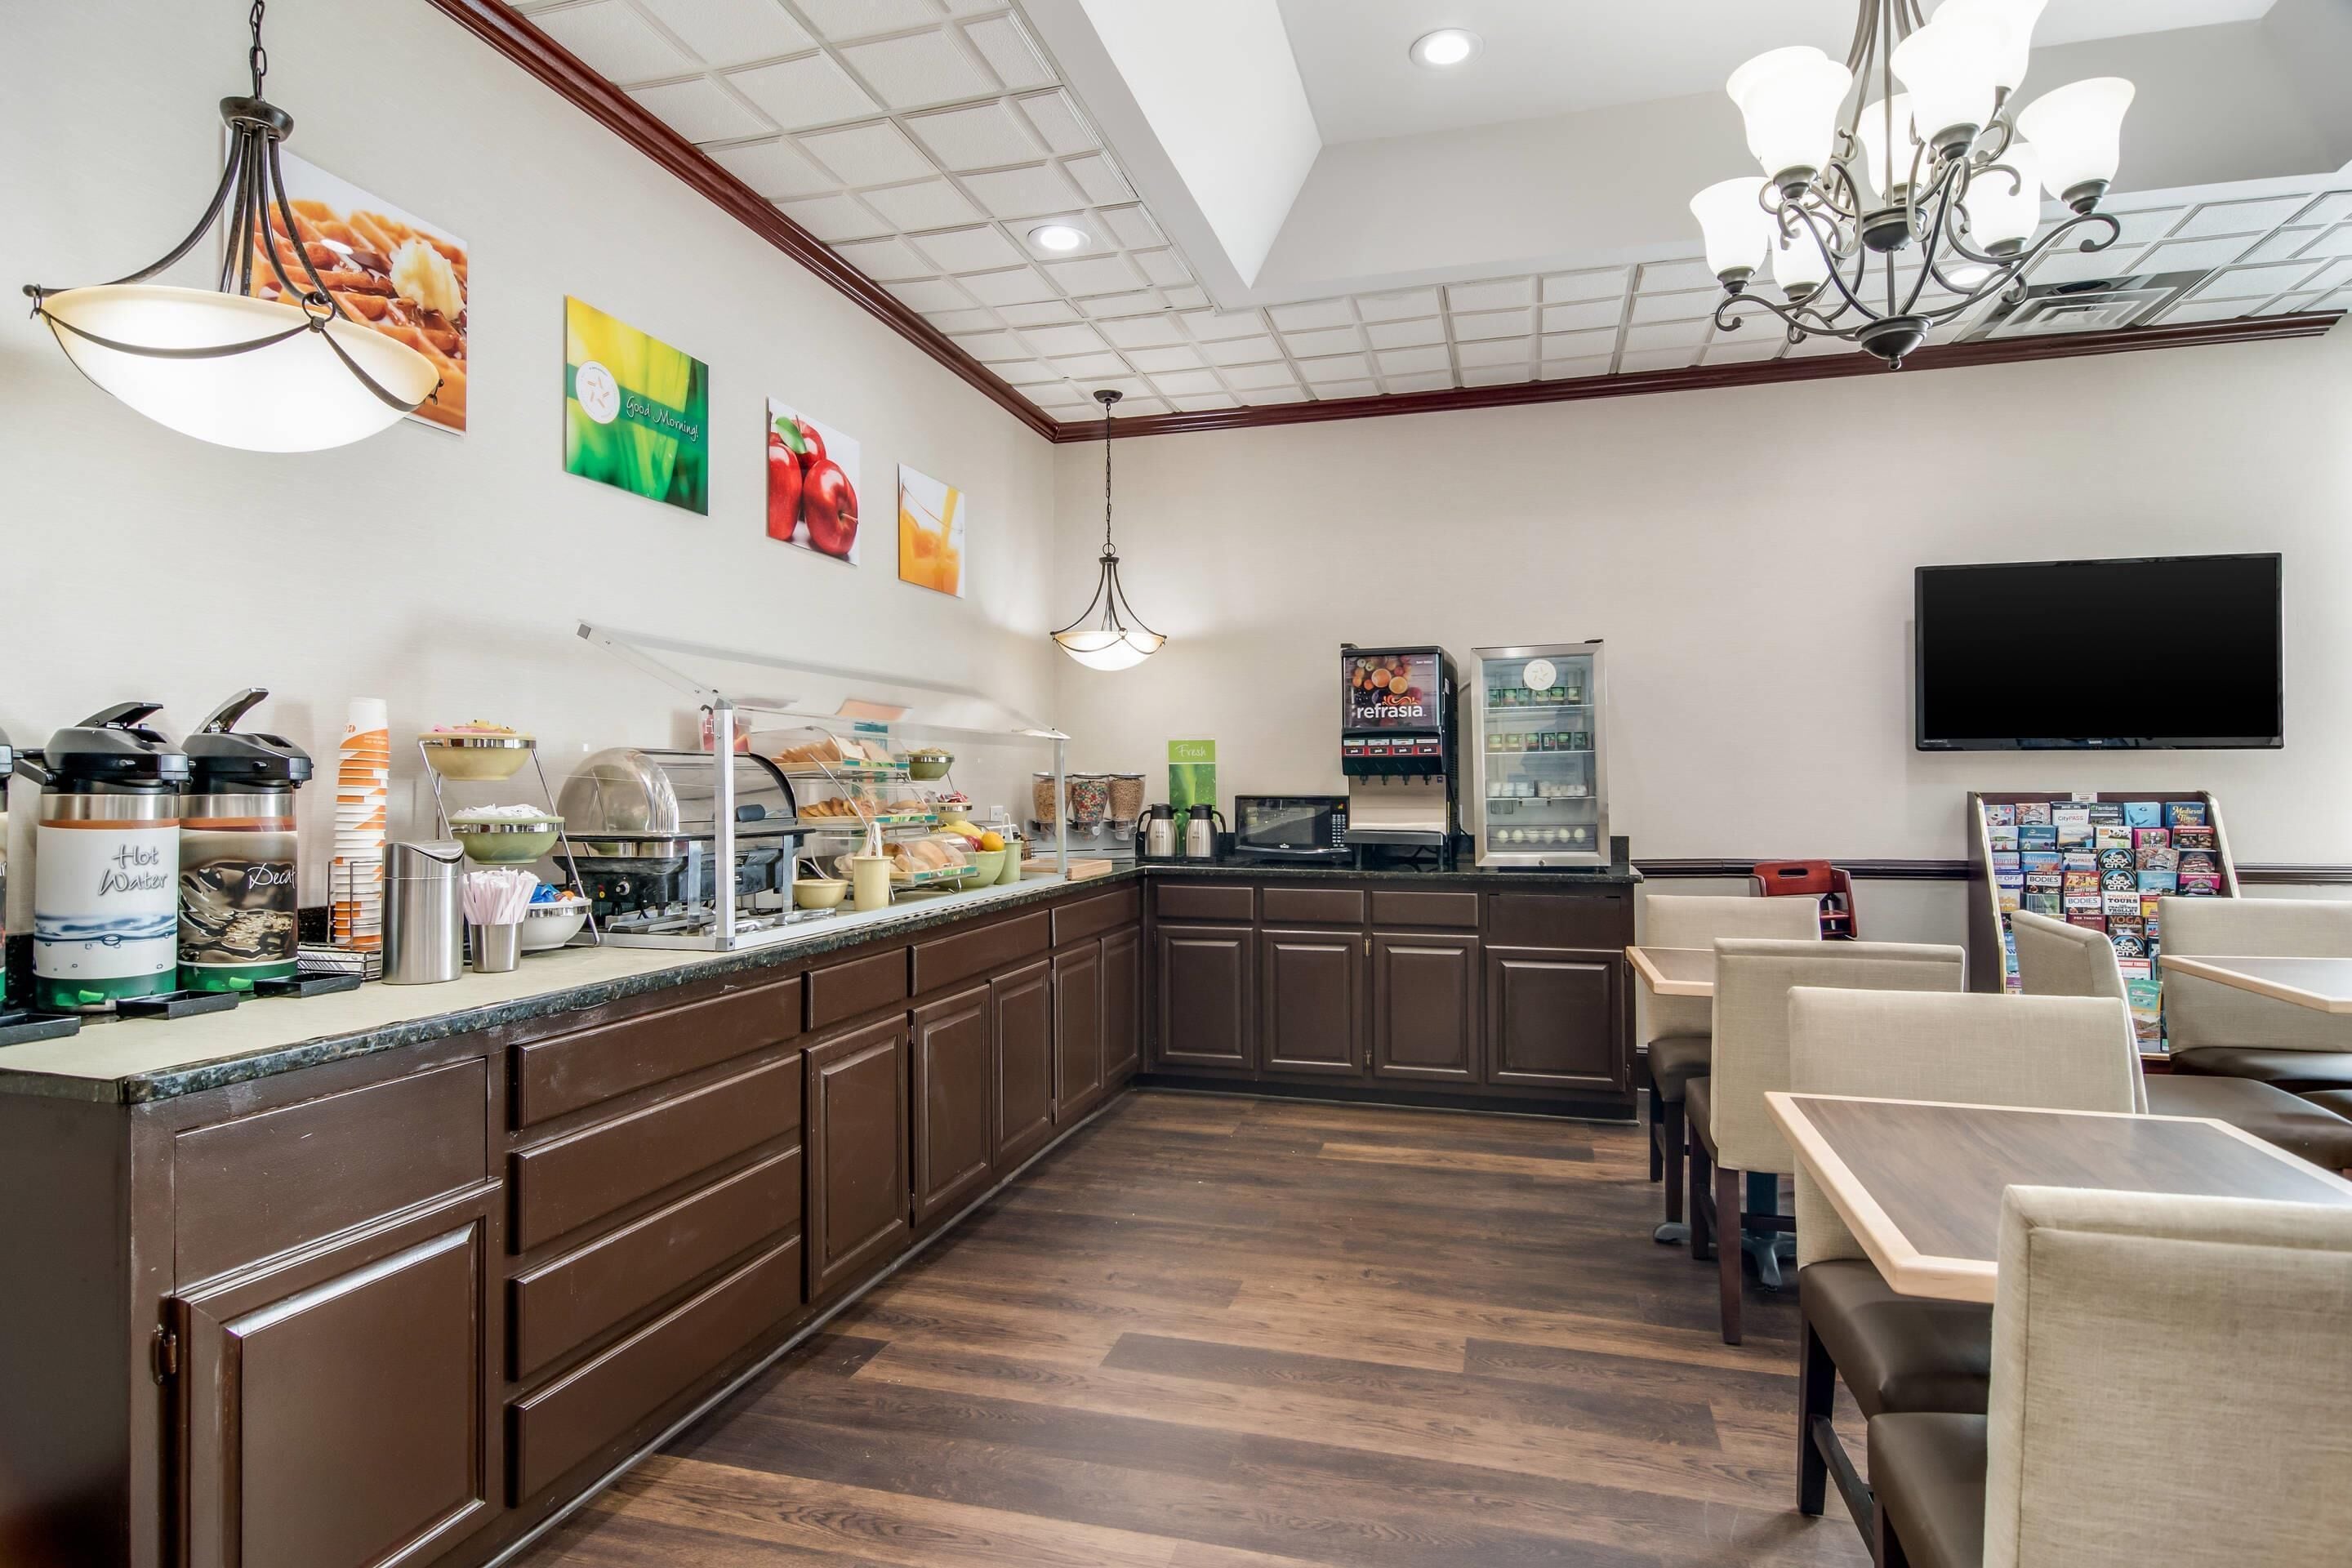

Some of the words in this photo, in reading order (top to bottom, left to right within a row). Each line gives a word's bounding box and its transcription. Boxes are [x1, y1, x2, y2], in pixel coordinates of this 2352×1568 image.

[626, 395, 651, 418] Good
[653, 408, 699, 442] Morning!
[1356, 702, 1423, 719] refrasia
[1175, 743, 1206, 757] Fresh
[2172, 805, 2204, 815] Medieval
[111, 844, 159, 869] Hot
[1993, 856, 2018, 864] tlanta
[2024, 855, 2060, 863] Atlanta
[98, 869, 168, 897] Water
[247, 862, 296, 889] Decaf
[2110, 915, 2143, 924] YOGA
